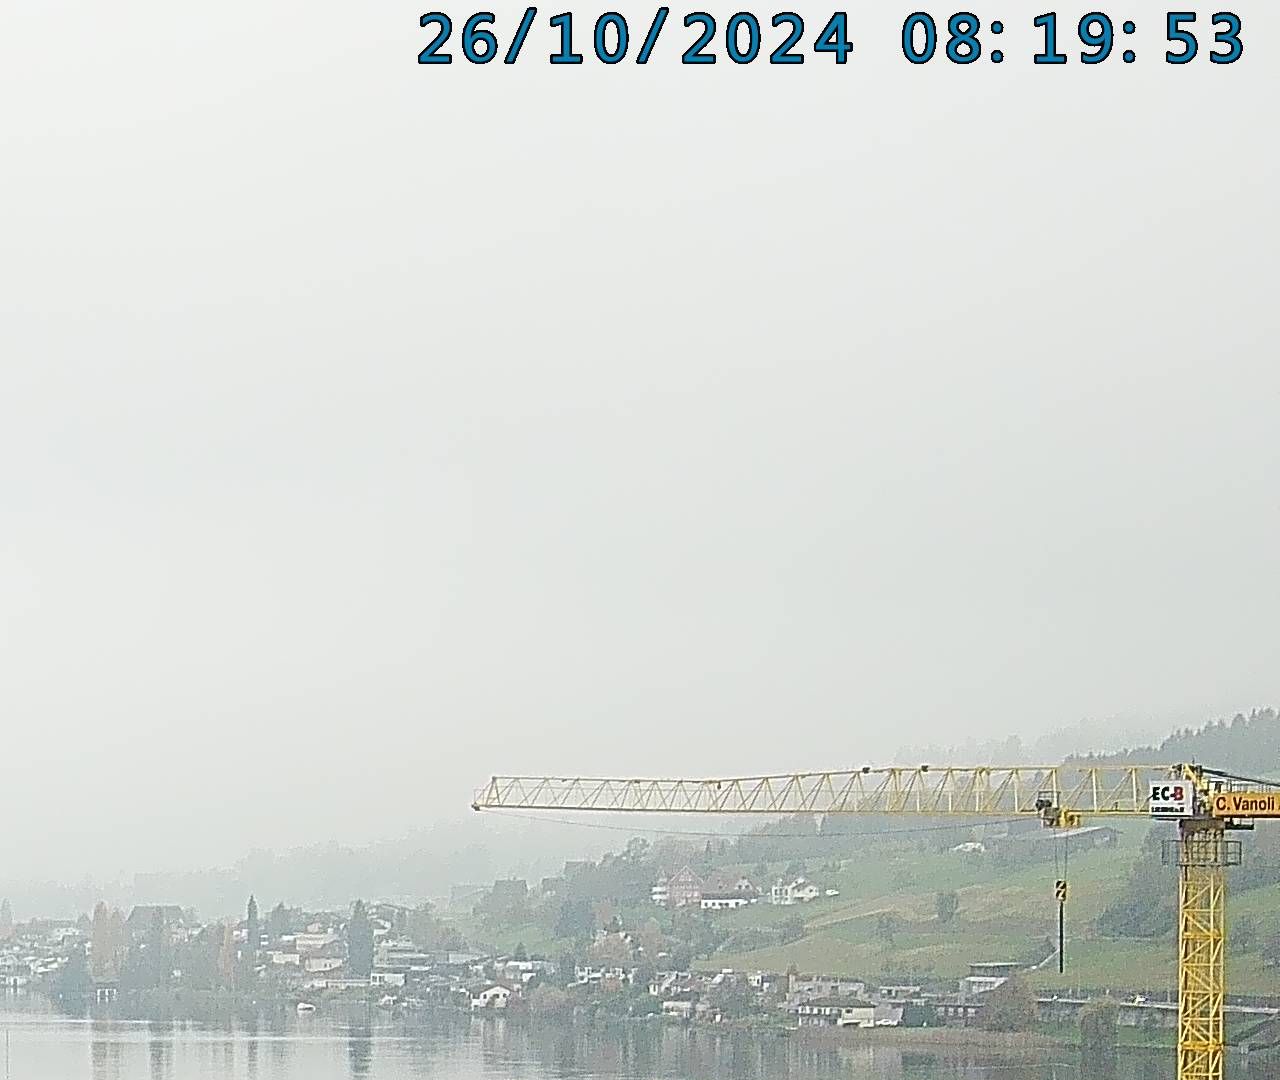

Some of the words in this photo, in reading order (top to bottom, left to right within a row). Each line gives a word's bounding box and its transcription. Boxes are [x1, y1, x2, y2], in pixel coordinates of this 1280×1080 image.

[1152, 786, 1184, 801] EC-B
[1216, 796, 1230, 811] C.
[1232, 796, 1275, 811] Vanoli
